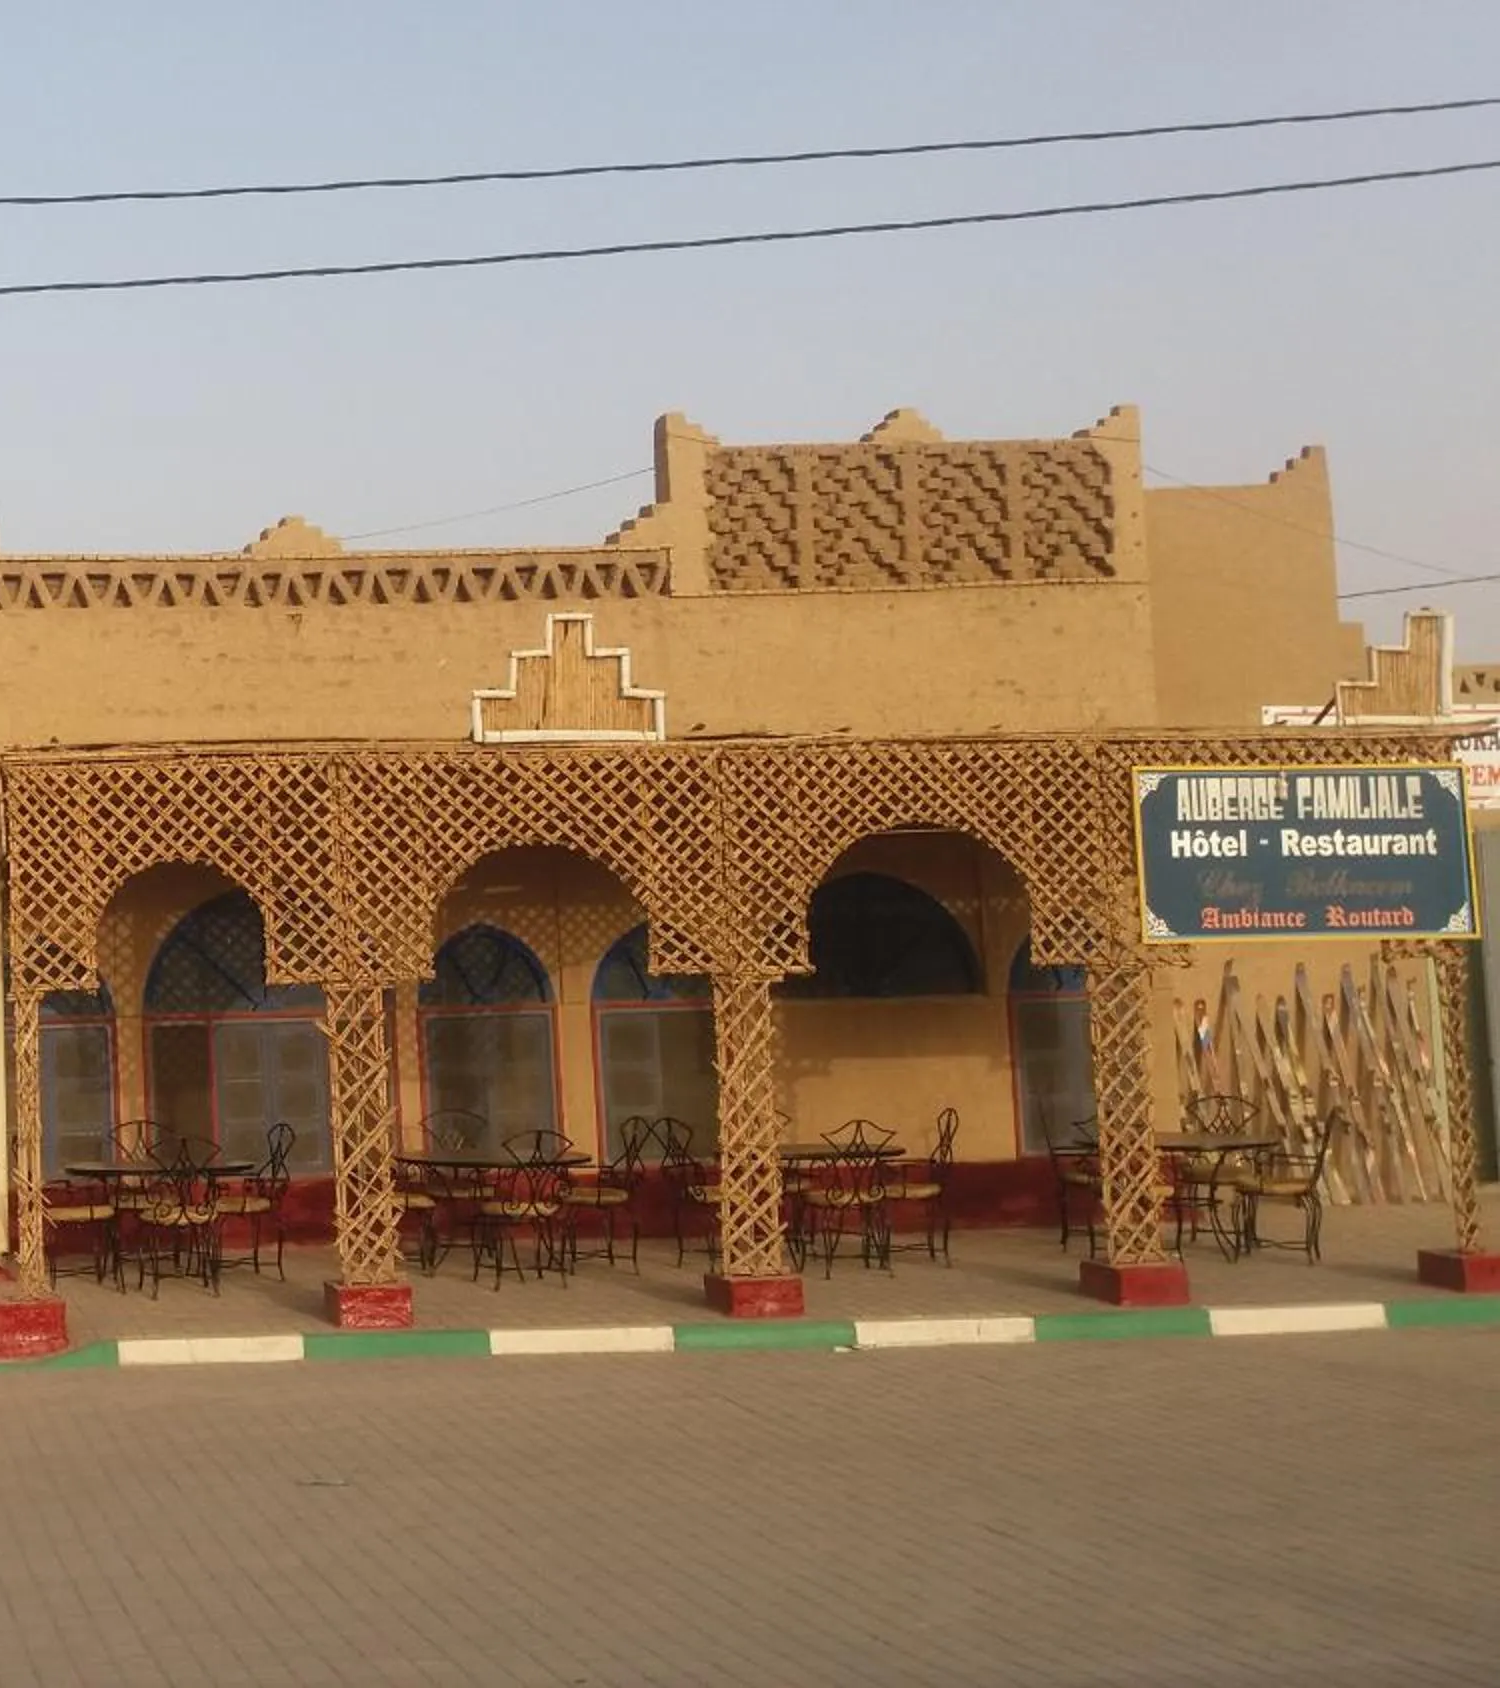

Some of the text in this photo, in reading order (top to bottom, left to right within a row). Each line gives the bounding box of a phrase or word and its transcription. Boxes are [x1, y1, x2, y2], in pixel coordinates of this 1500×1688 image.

[1177, 775, 1424, 821] AUBERGE FAMILIALE
[1171, 829, 1248, 858] Hôtel
[1280, 828, 1438, 857] Restaurant
[1201, 903, 1415, 930] Ambiance Routard
